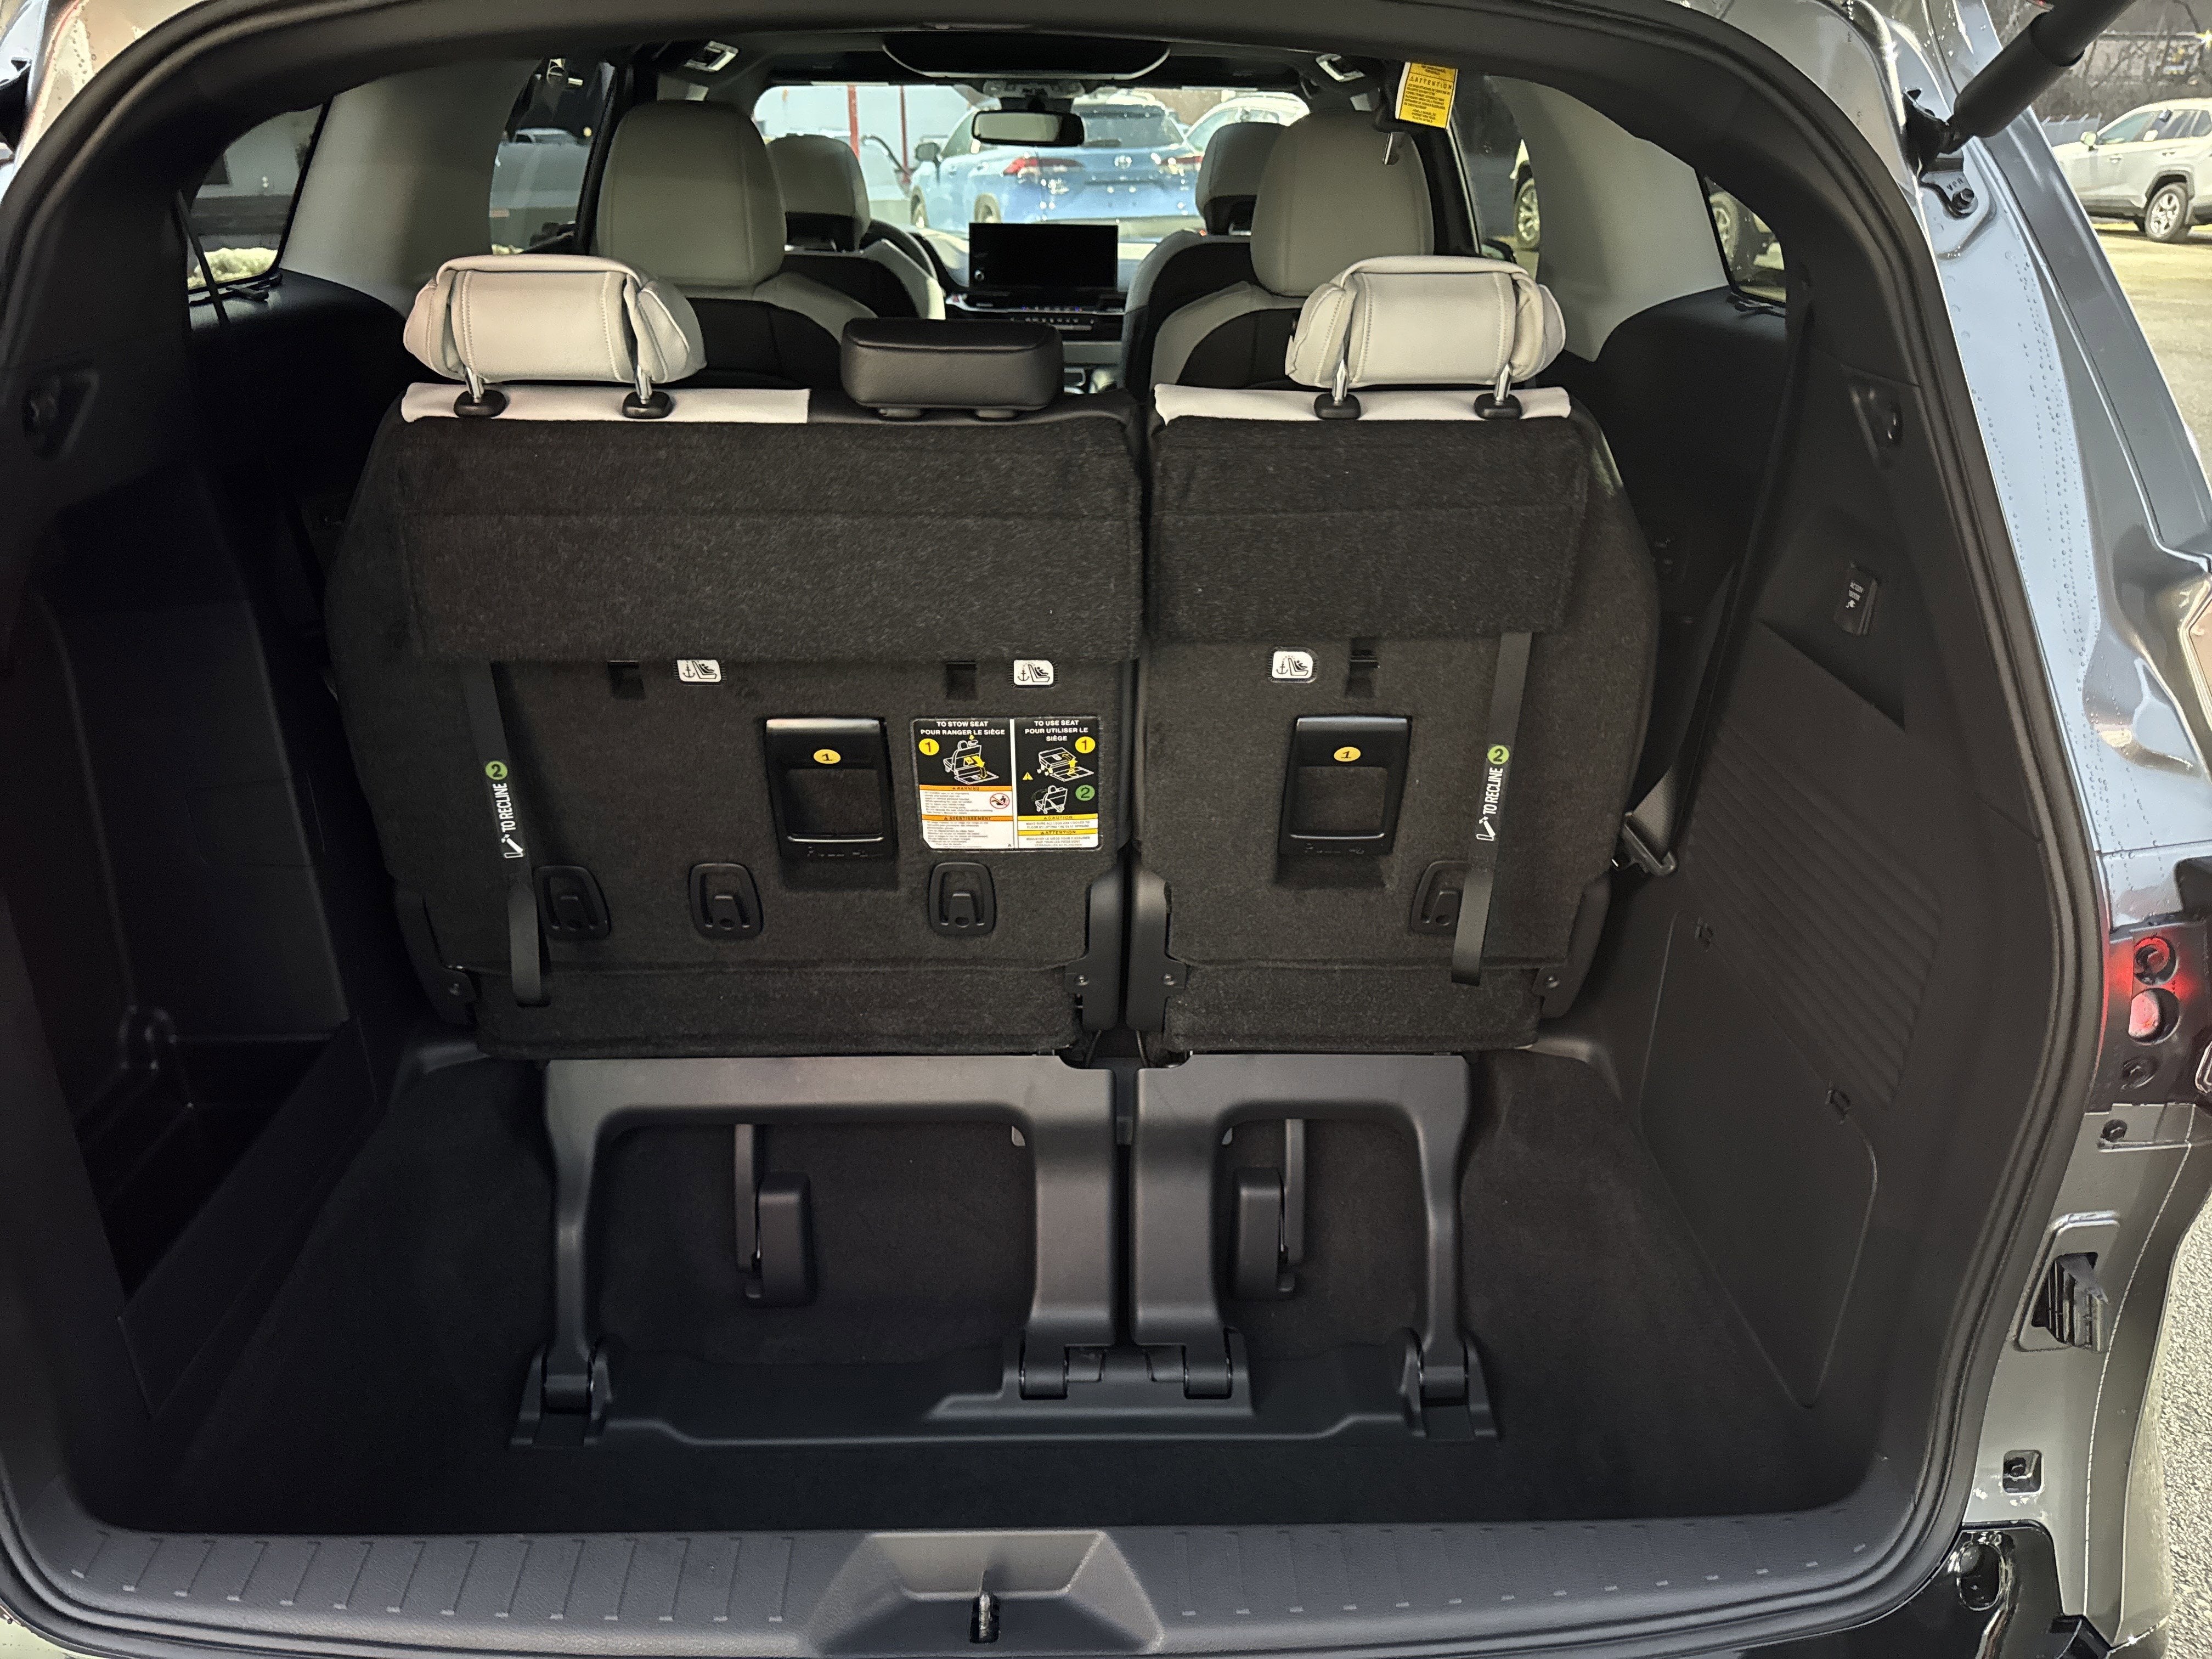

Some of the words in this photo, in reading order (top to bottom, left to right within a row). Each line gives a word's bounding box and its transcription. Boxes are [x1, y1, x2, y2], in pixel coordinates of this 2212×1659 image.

[1415, 77, 1452, 90] ATTENTION
[1492, 748, 1504, 763] 2
[491, 763, 503, 778] 2
[1081, 787, 1090, 798] 2
[1484, 767, 1504, 804] RECLINE
[492, 782, 514, 820] RECLINE
[1482, 804, 1498, 815] TO
[500, 820, 516, 833] TO
